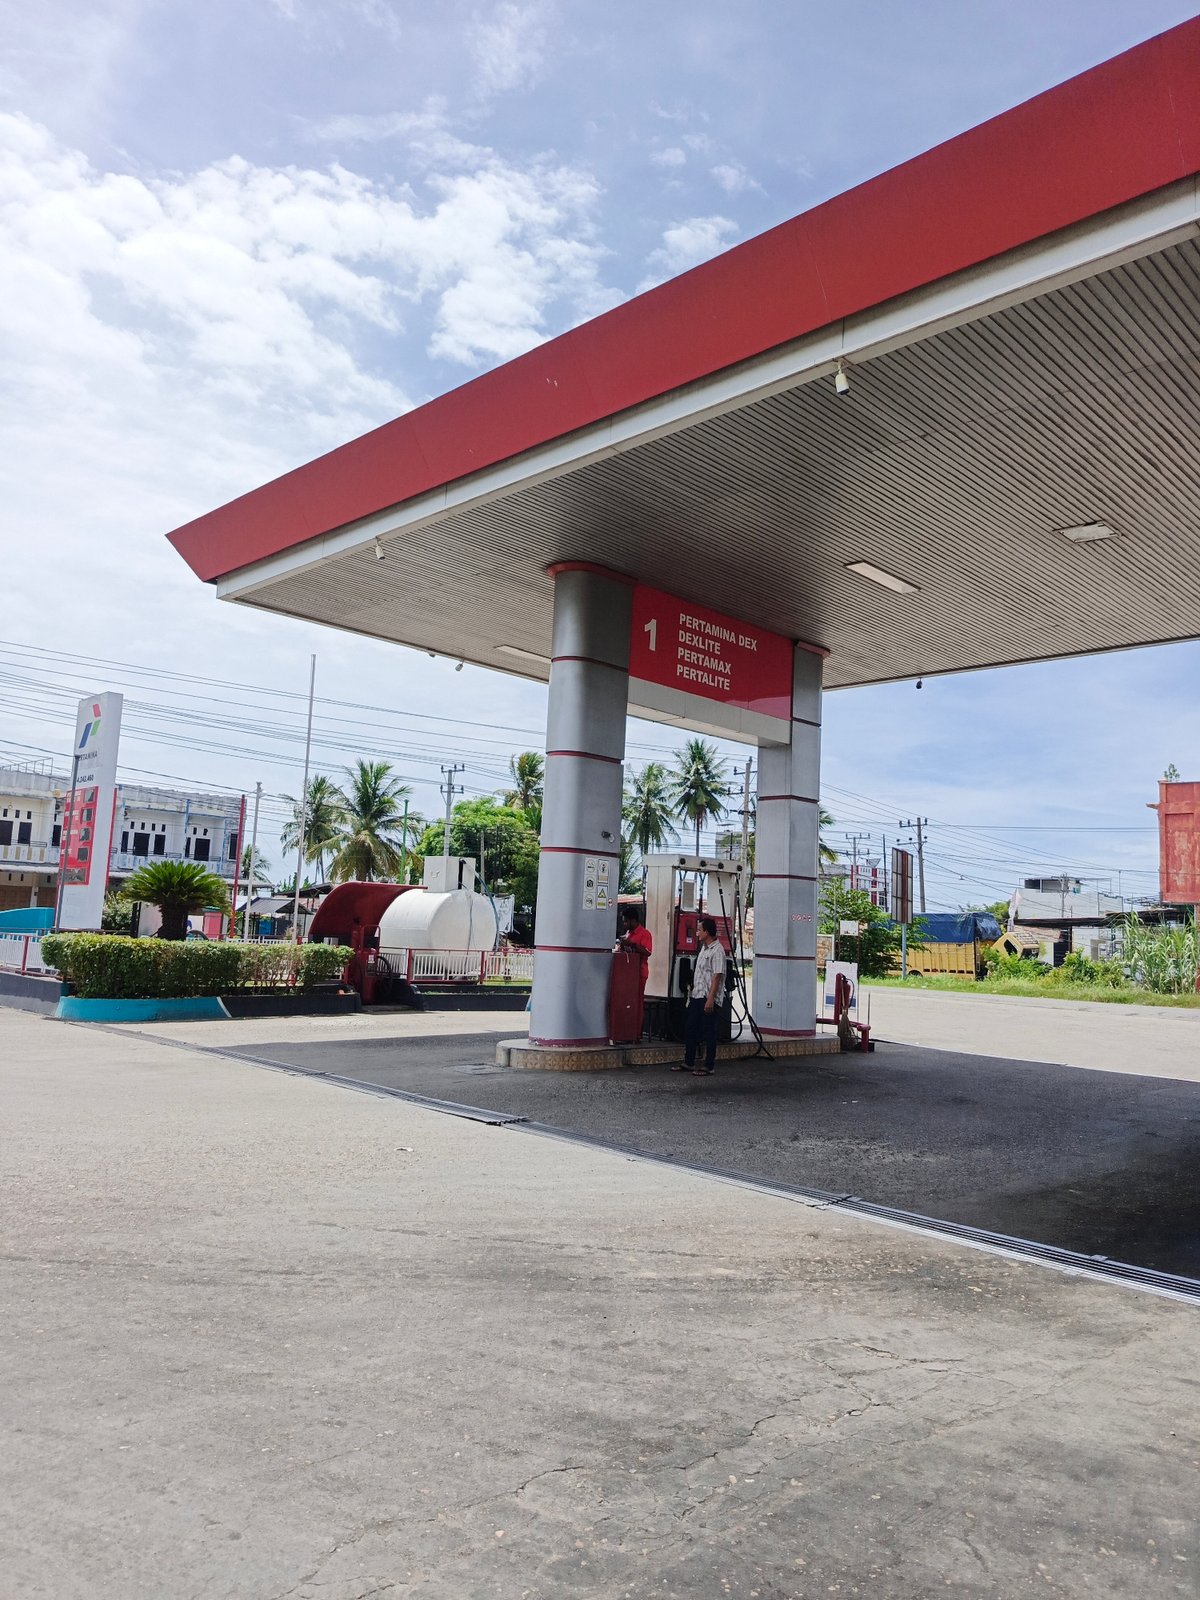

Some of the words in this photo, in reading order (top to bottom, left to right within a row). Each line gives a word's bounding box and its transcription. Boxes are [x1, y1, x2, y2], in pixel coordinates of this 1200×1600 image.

[644, 618, 657, 652] 1
[678, 630, 721, 655] DEXLITE
[679, 613, 736, 644] PERTAMINA
[738, 634, 757, 651] DEX
[677, 647, 732, 675] PERTAMAX
[676, 664, 731, 691] PERTALITE
